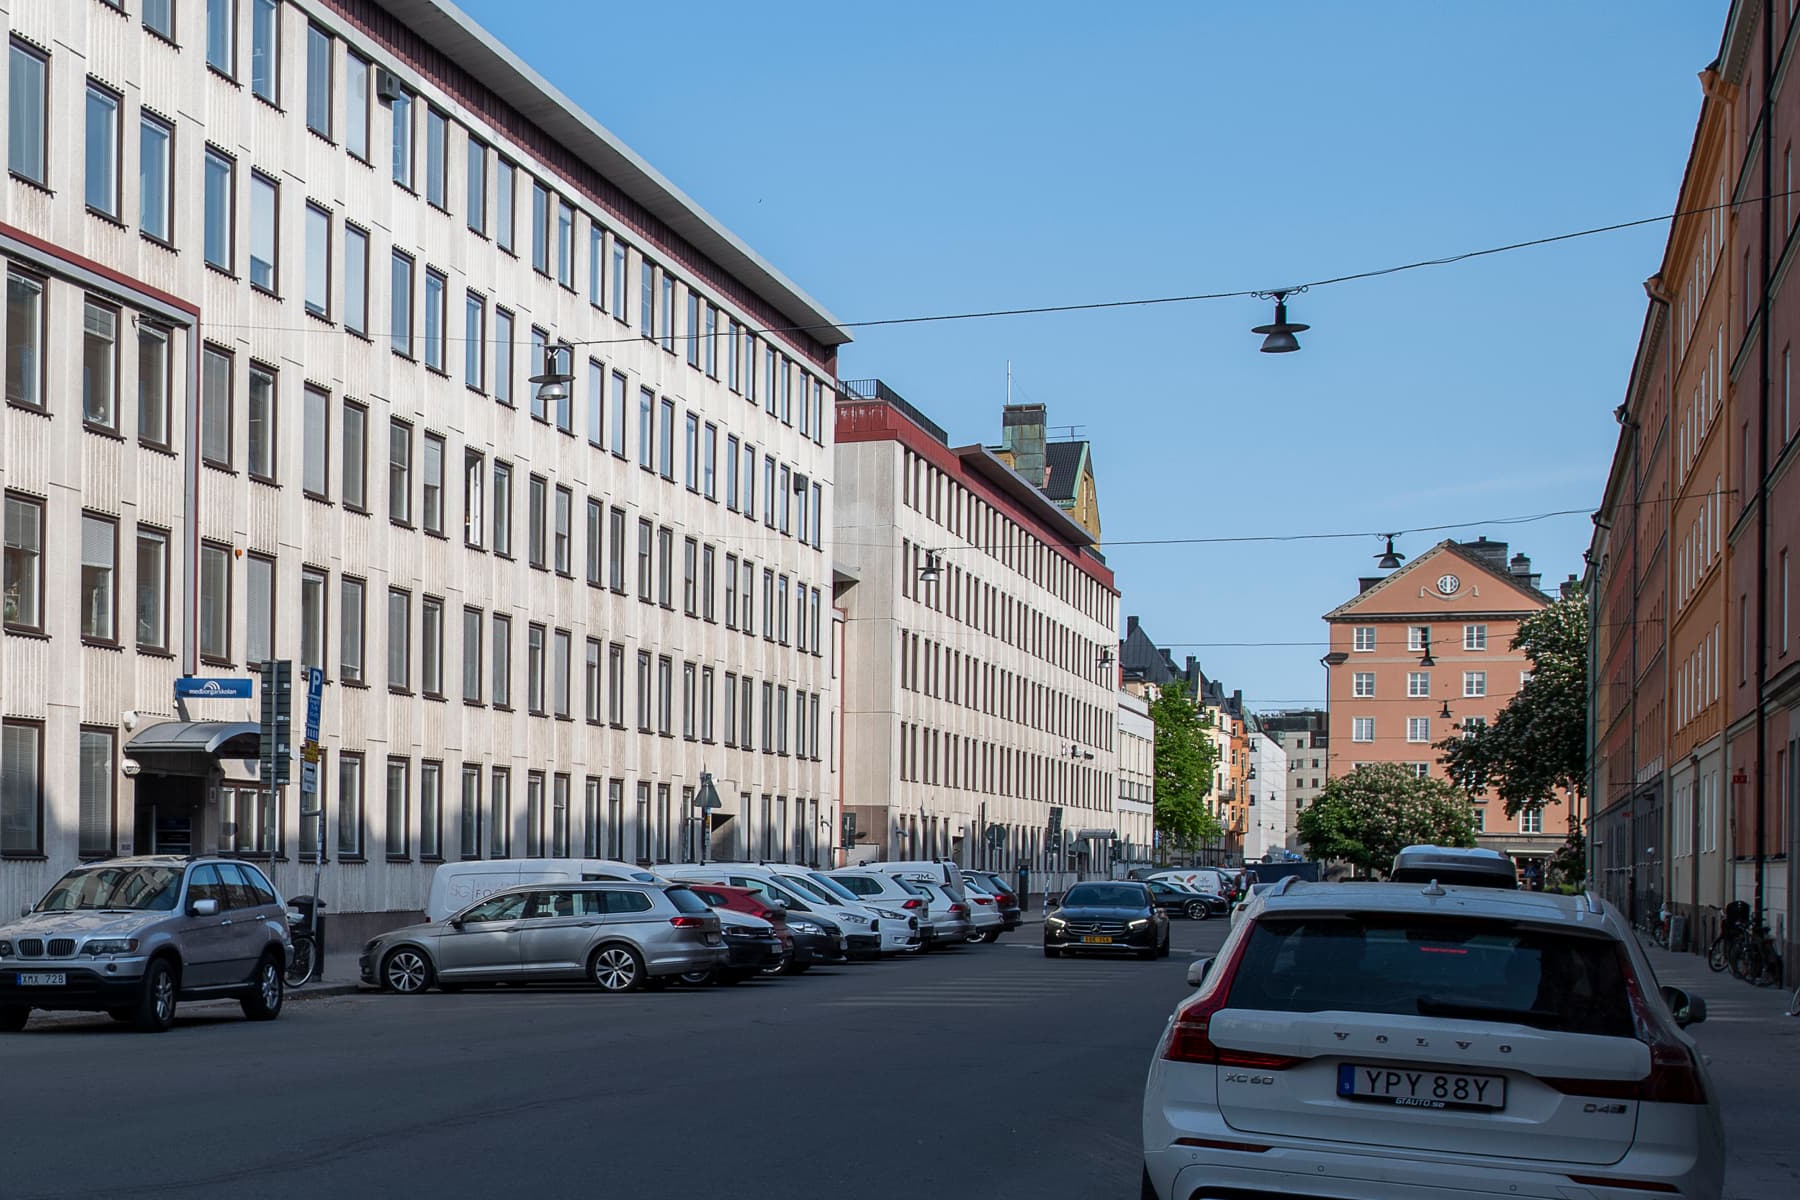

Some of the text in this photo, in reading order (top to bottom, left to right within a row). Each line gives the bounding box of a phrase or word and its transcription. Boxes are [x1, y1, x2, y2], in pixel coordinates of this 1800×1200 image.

[311, 670, 321, 693] P
[45, 974, 64, 984] 728
[1333, 1031, 1512, 1054] VOLVO
[1365, 1069, 1491, 1102] YPY 88Y
